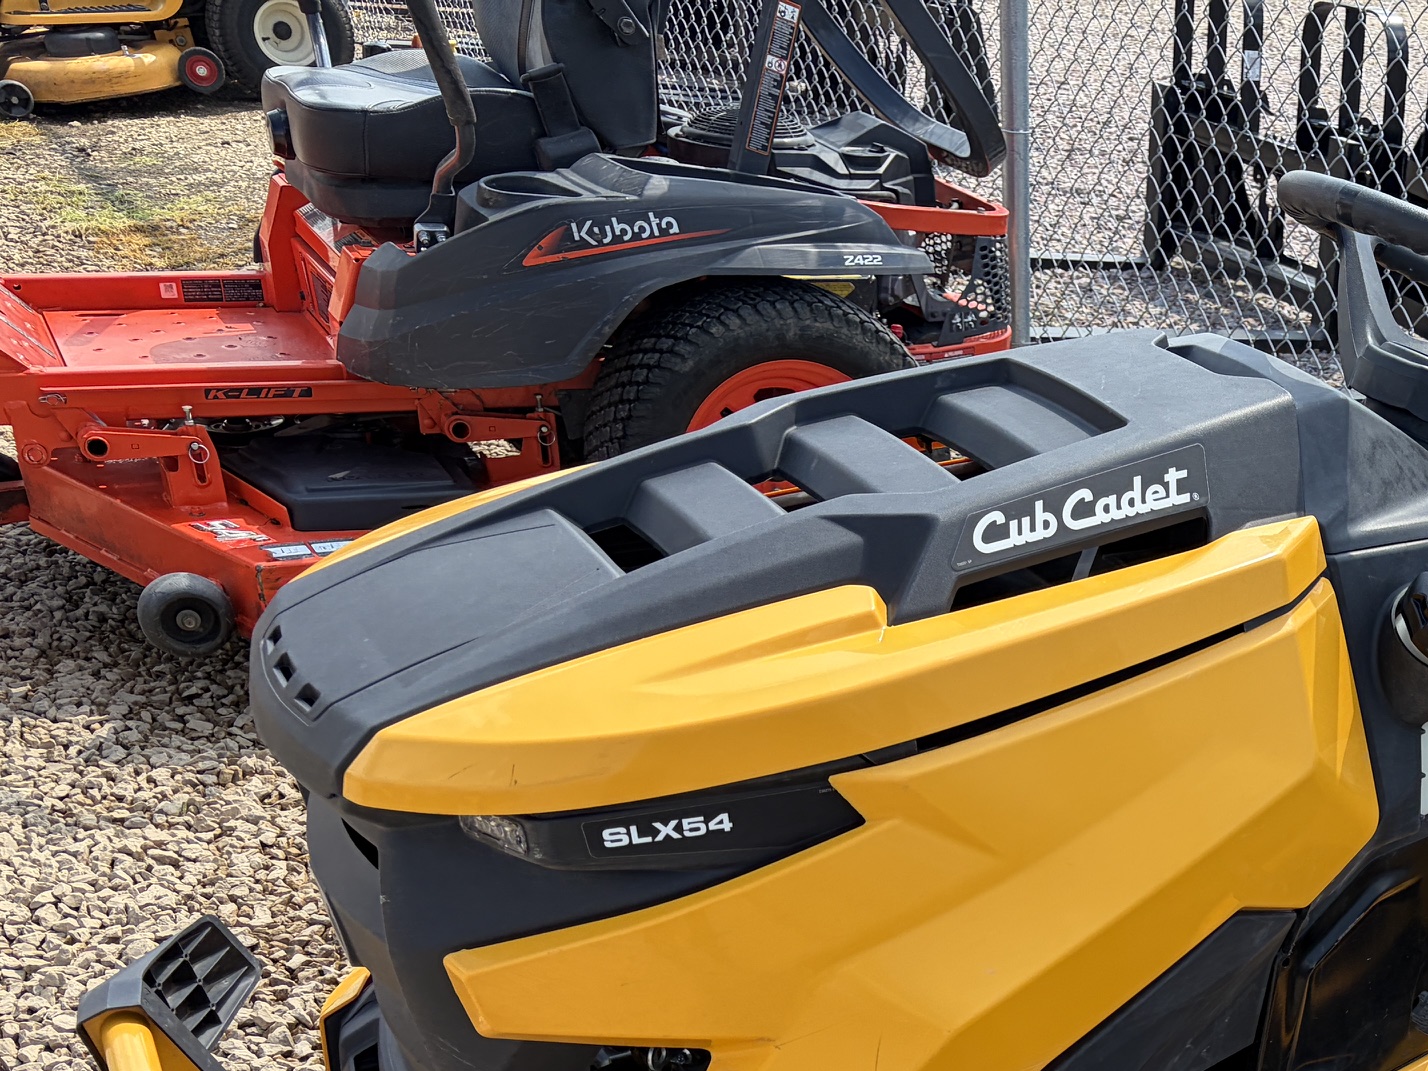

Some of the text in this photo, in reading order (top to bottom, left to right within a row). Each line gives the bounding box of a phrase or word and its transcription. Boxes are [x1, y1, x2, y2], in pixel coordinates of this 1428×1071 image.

[570, 212, 680, 246] Kubota
[843, 254, 883, 266] Z422
[207, 387, 309, 400] K-LIFT
[972, 466, 1191, 554] Cub Cadet
[602, 812, 734, 848] SLX54
